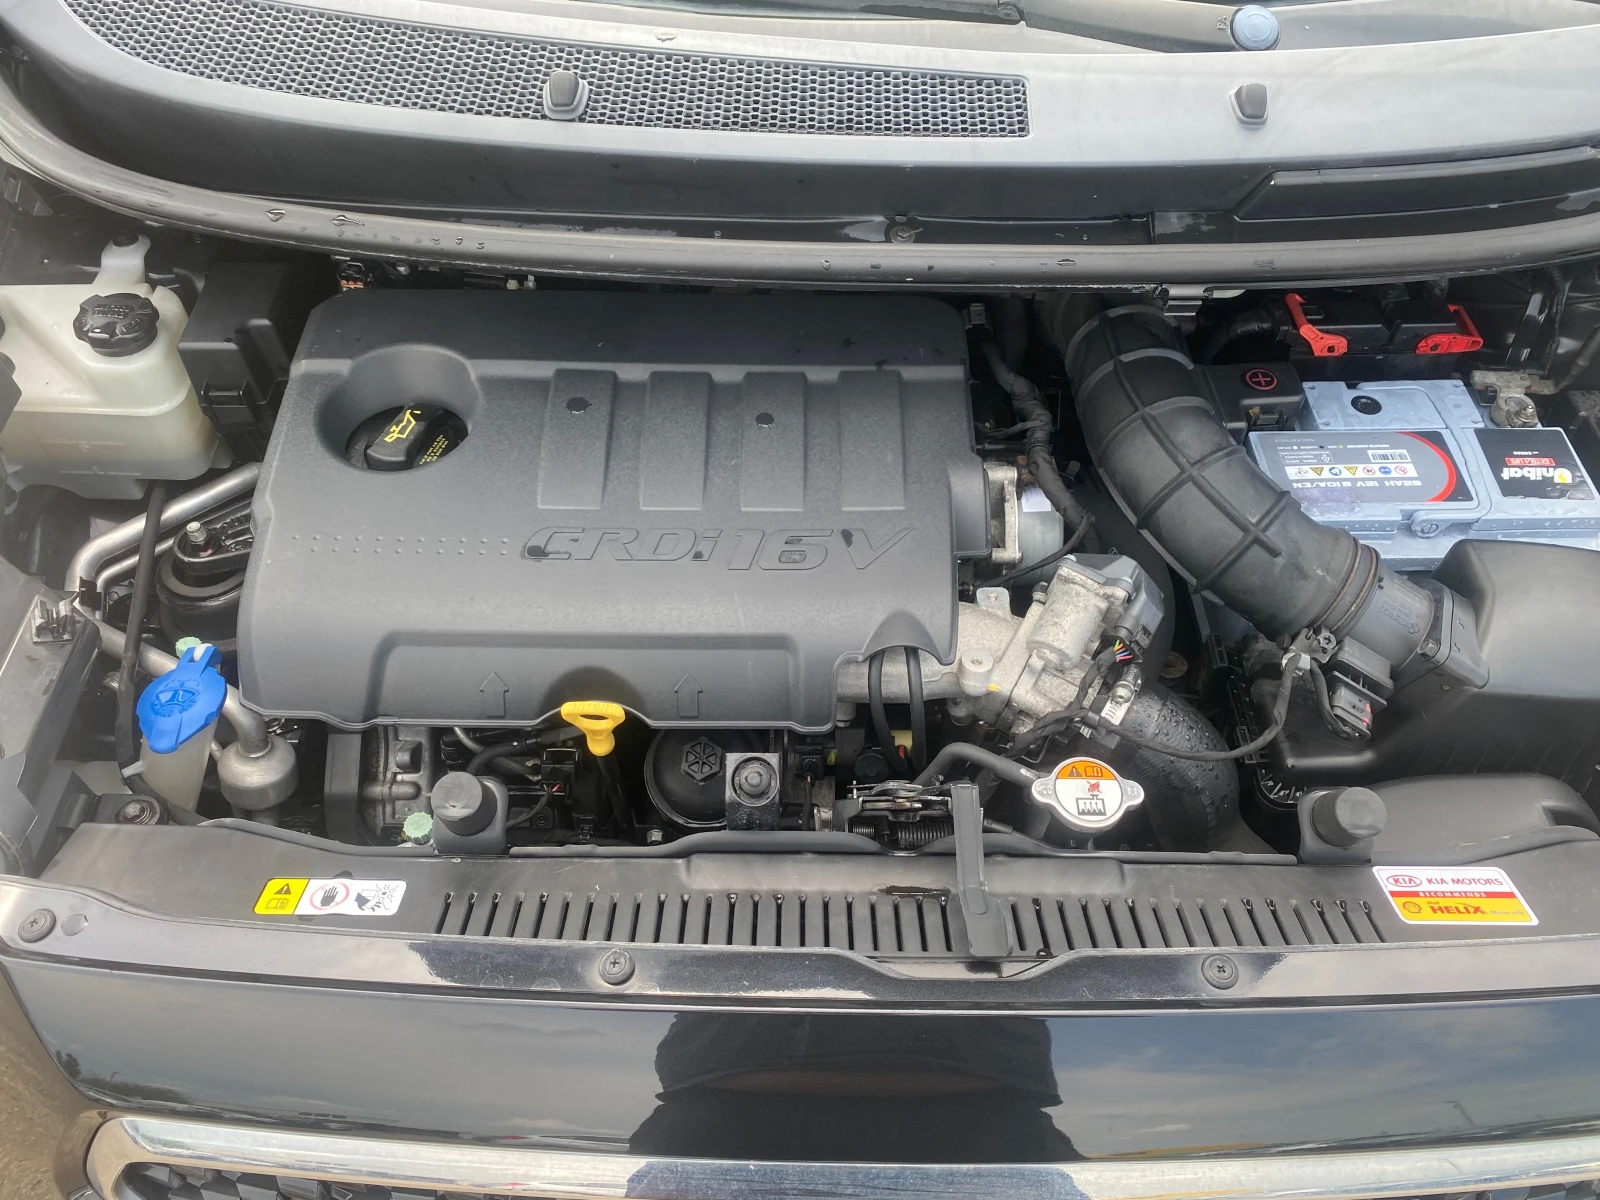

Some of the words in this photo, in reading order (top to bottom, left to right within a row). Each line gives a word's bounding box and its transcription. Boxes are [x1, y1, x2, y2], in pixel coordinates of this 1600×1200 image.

[1501, 467, 1573, 483] Unibat
[727, 526, 915, 571] 16V
[1393, 877, 1419, 886] KIA
[1426, 877, 1449, 885] KIA
[1450, 877, 1504, 886] MOTORS
[1430, 905, 1488, 915] HELIX
